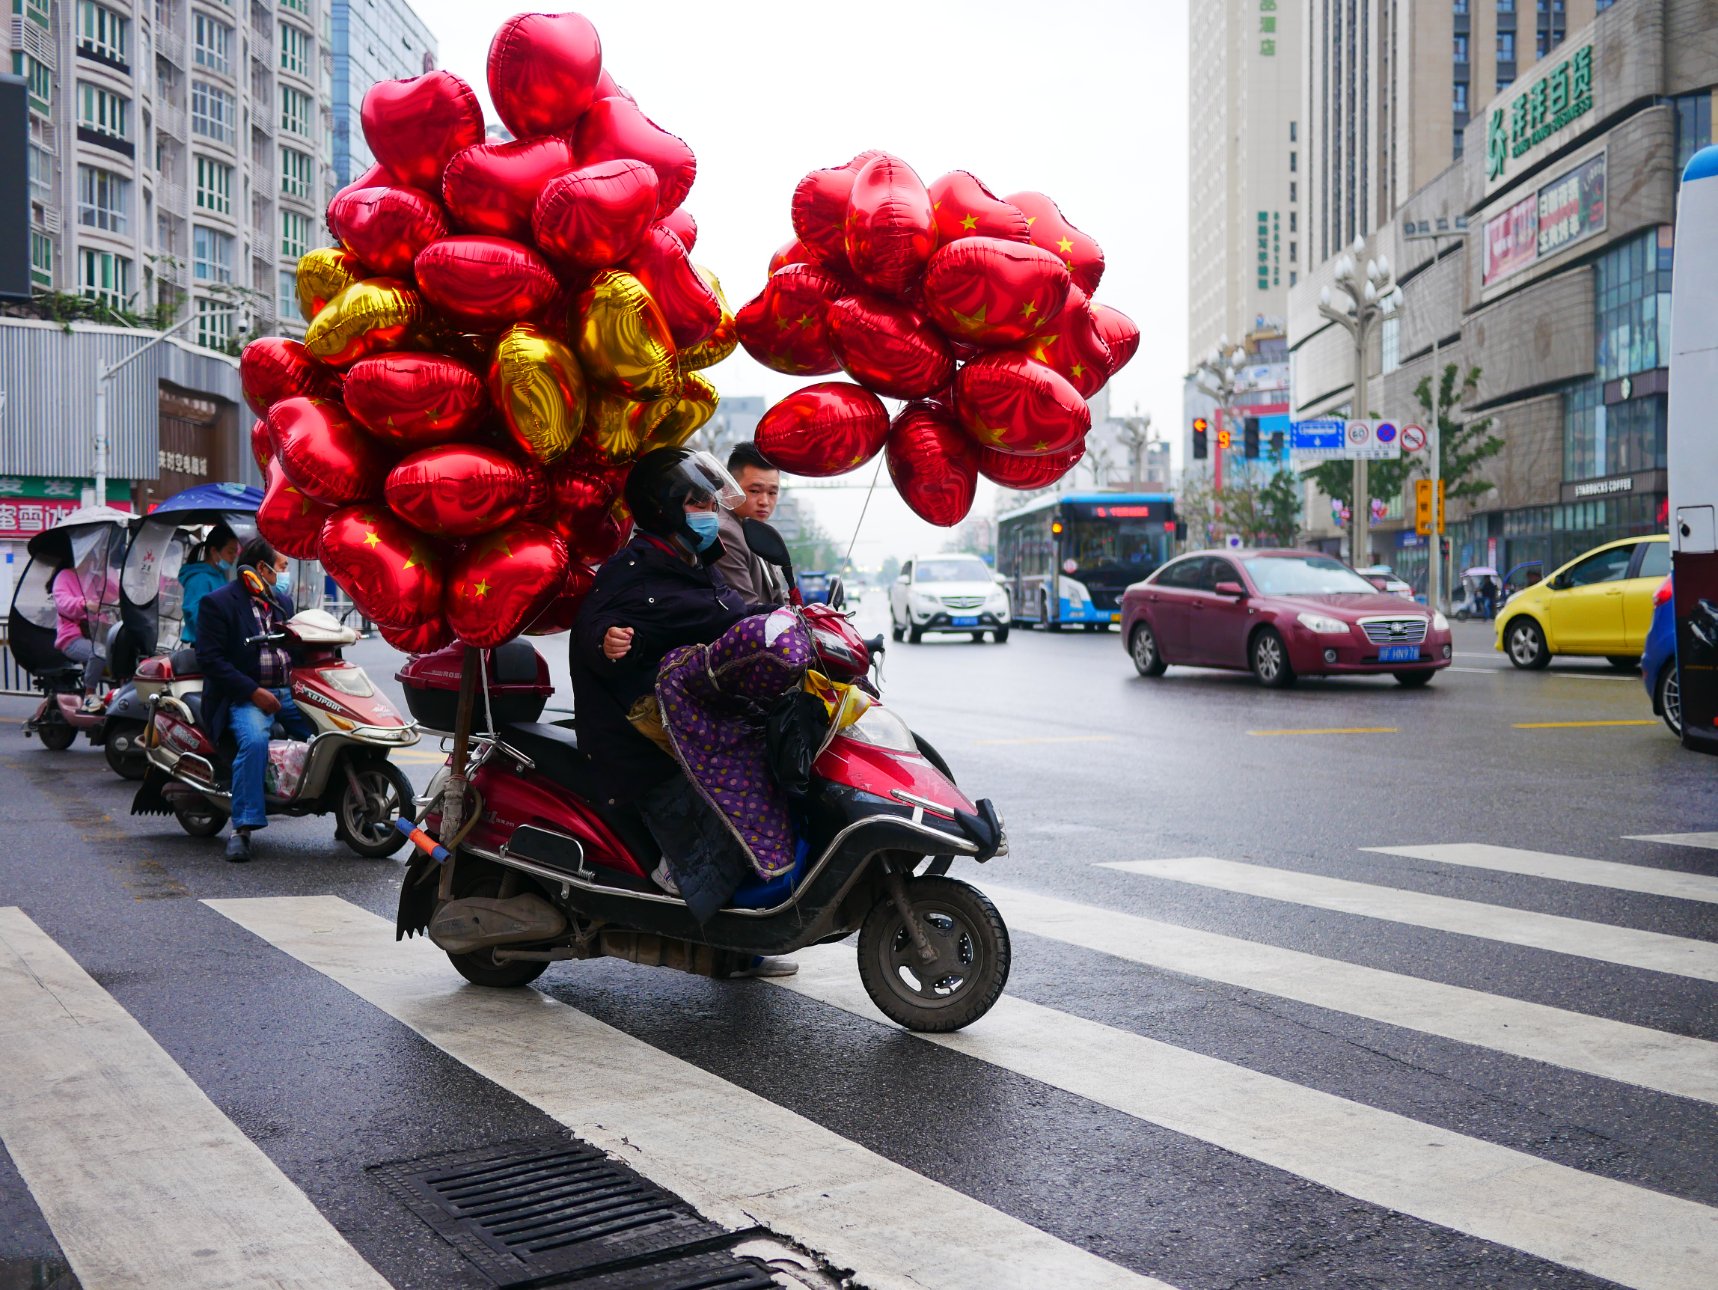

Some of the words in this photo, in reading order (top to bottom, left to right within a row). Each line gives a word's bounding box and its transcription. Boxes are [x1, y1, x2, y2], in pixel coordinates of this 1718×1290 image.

[1218, 430, 1231, 449] 9
[1575, 481, 1608, 498] STARBUCKS
[1608, 477, 1632, 493] COFFEE
[0, 503, 78, 531] 蜜雪冰
